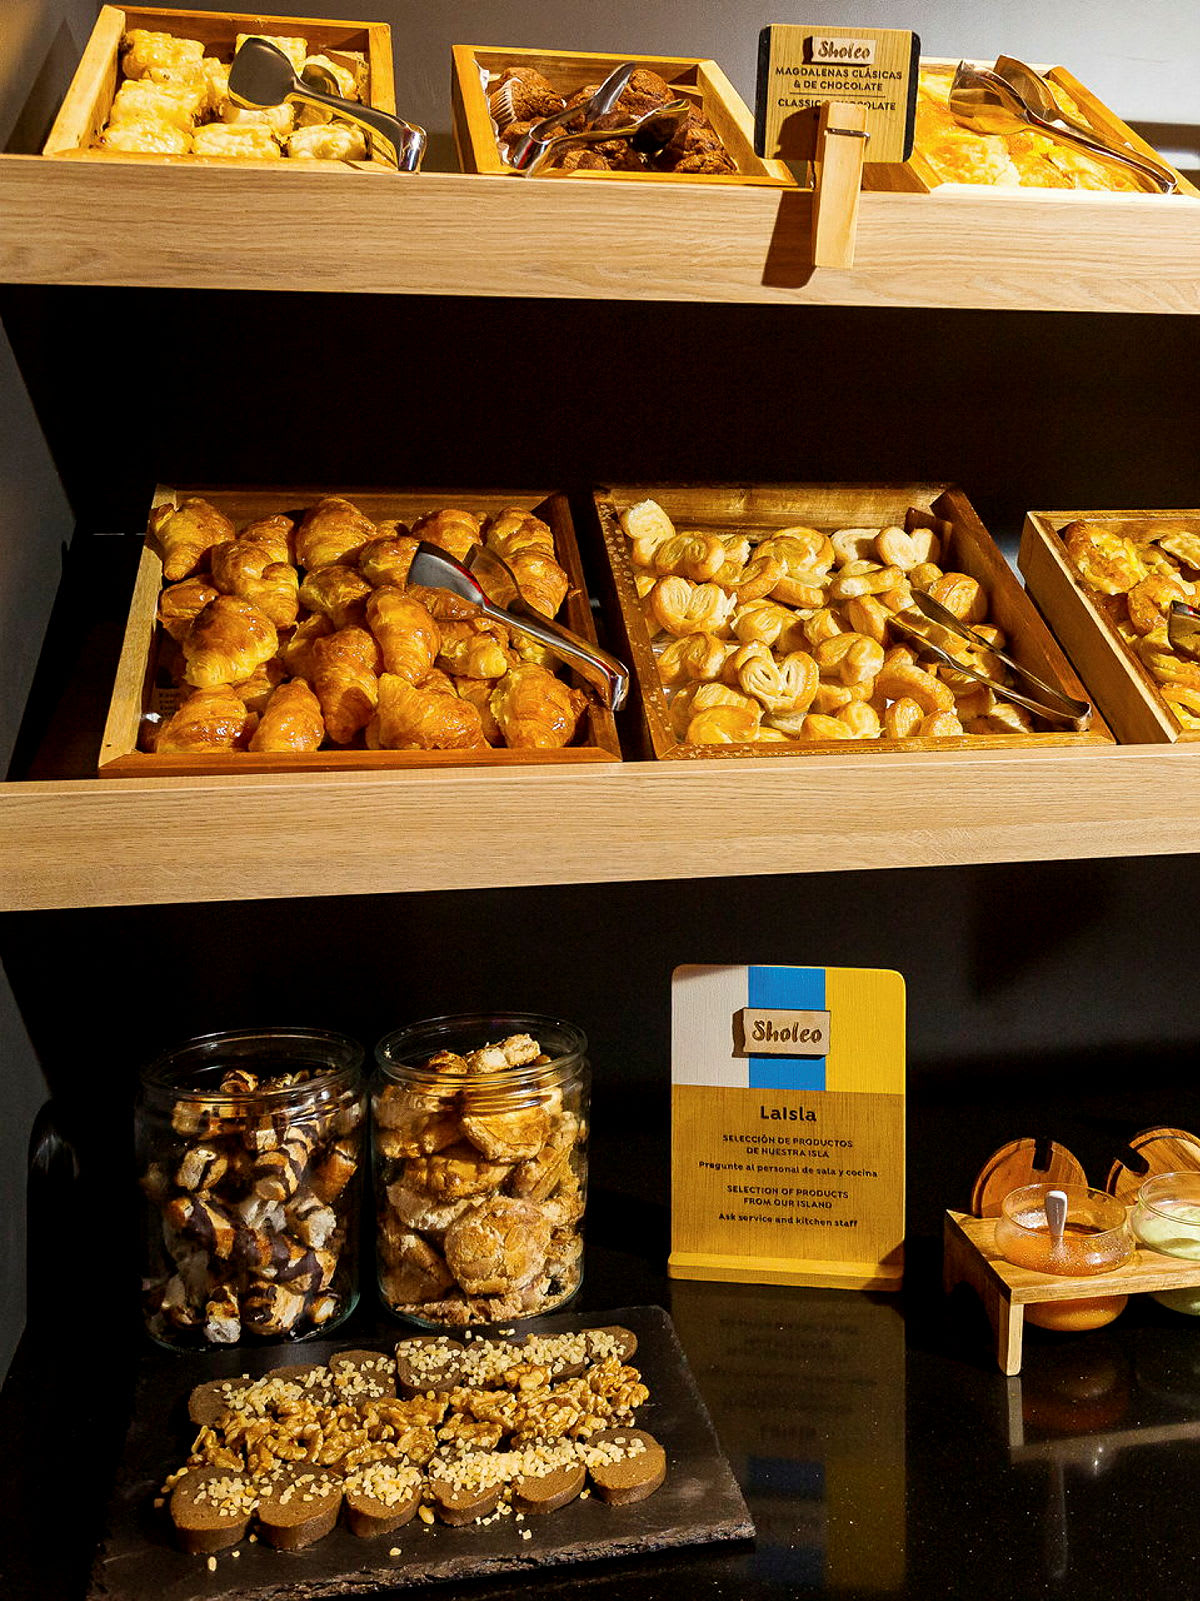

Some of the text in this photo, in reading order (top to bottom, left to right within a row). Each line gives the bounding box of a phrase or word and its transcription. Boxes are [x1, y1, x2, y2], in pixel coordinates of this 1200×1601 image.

[775, 67, 903, 80] MAGDALENAS CLÁSICAS
[794, 80, 883, 92] & DE CHOCOLATE
[778, 98, 820, 108] CLASSIC
[760, 1105, 817, 1122] LaIsla
[722, 1134, 853, 1148] SELECCIÓN DE PRODUCTOS
[746, 1147, 829, 1158] DE NUESTRA ISLA
[698, 1161, 743, 1171] Pregunte
[757, 1165, 800, 1174] personal
[802, 1166, 813, 1174] de
[816, 1167, 836, 1175] sala
[846, 1168, 878, 1177] cocina
[727, 1185, 849, 1199] SELECTION OF PRODUCTS
[743, 1197, 832, 1209] FROM OUR ISLAND
[719, 1212, 858, 1227] Ask service and kitchen staff
